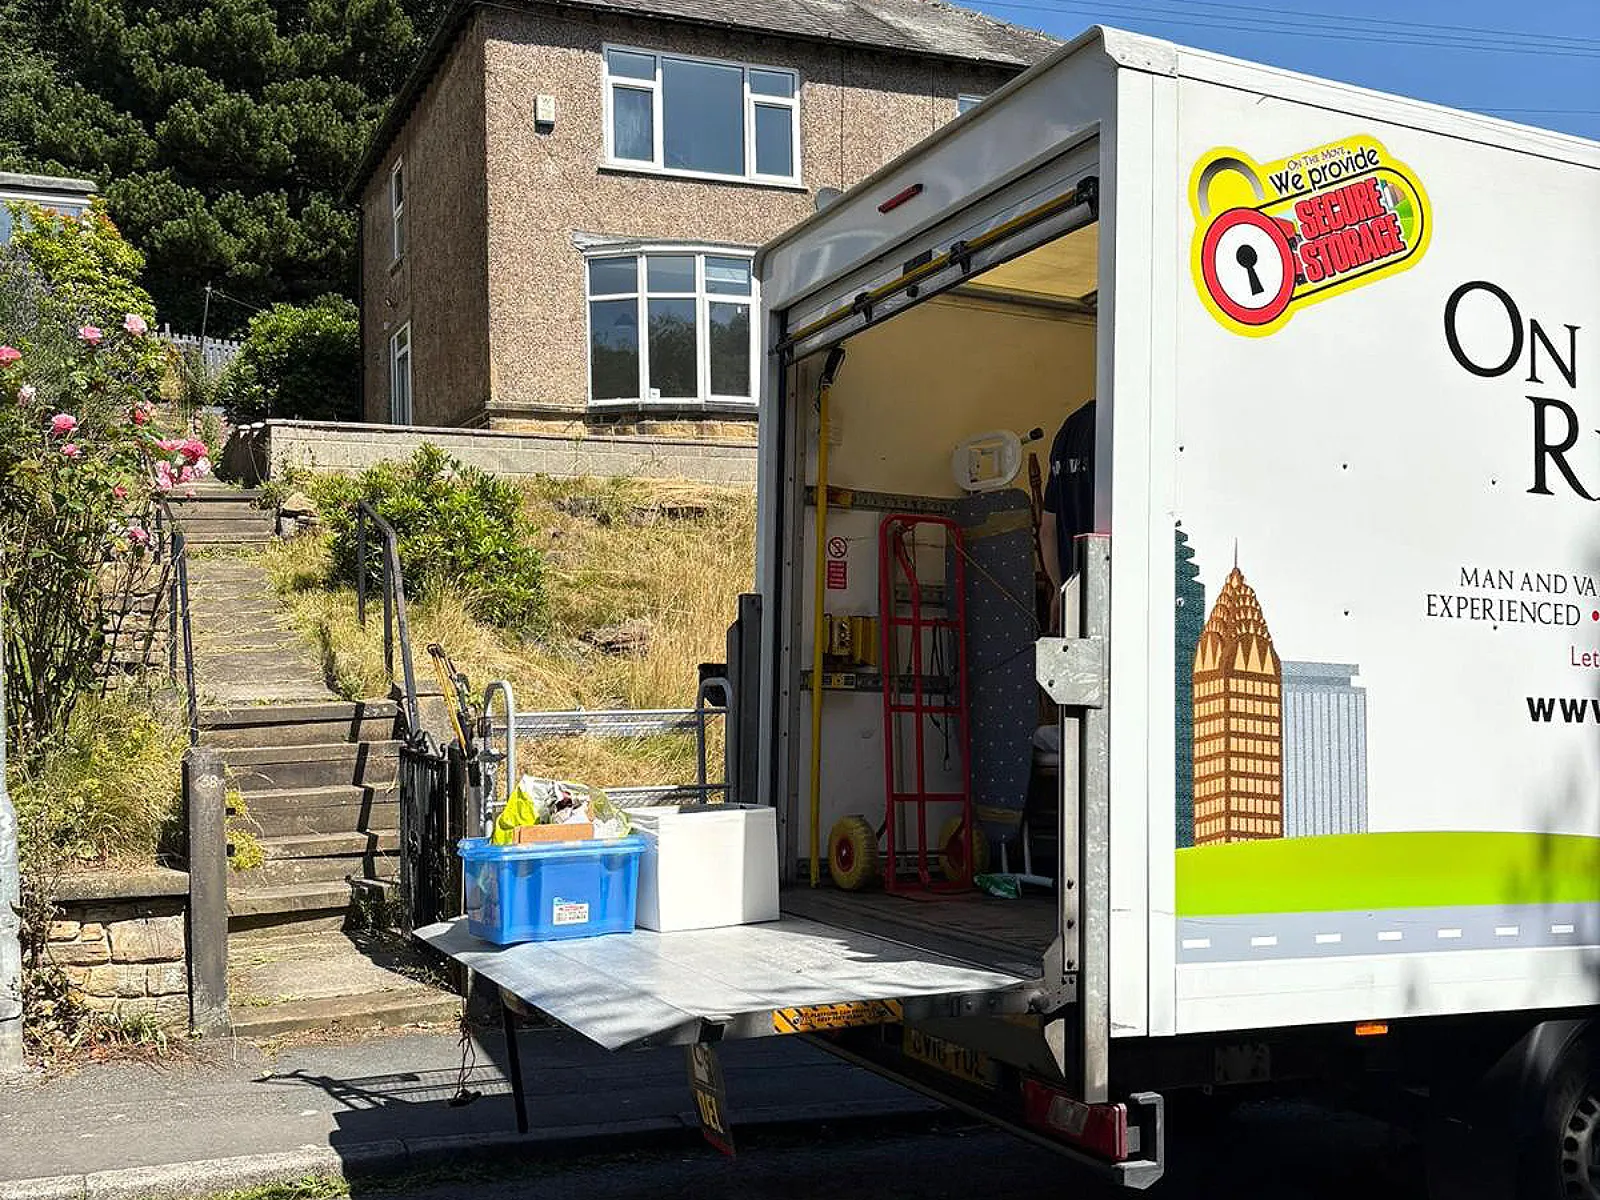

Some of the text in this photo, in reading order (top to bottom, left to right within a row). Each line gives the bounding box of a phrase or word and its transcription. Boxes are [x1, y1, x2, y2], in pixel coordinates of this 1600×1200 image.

[1268, 146, 1380, 195] We provide
[1295, 177, 1386, 241] SECURE
[1300, 213, 1407, 284] STORAGE
[1444, 280, 1582, 388] ON
[1525, 395, 1600, 502] R
[1426, 593, 1581, 626] EXPERIENCED
[1460, 567, 1600, 597] MAN AND VA
